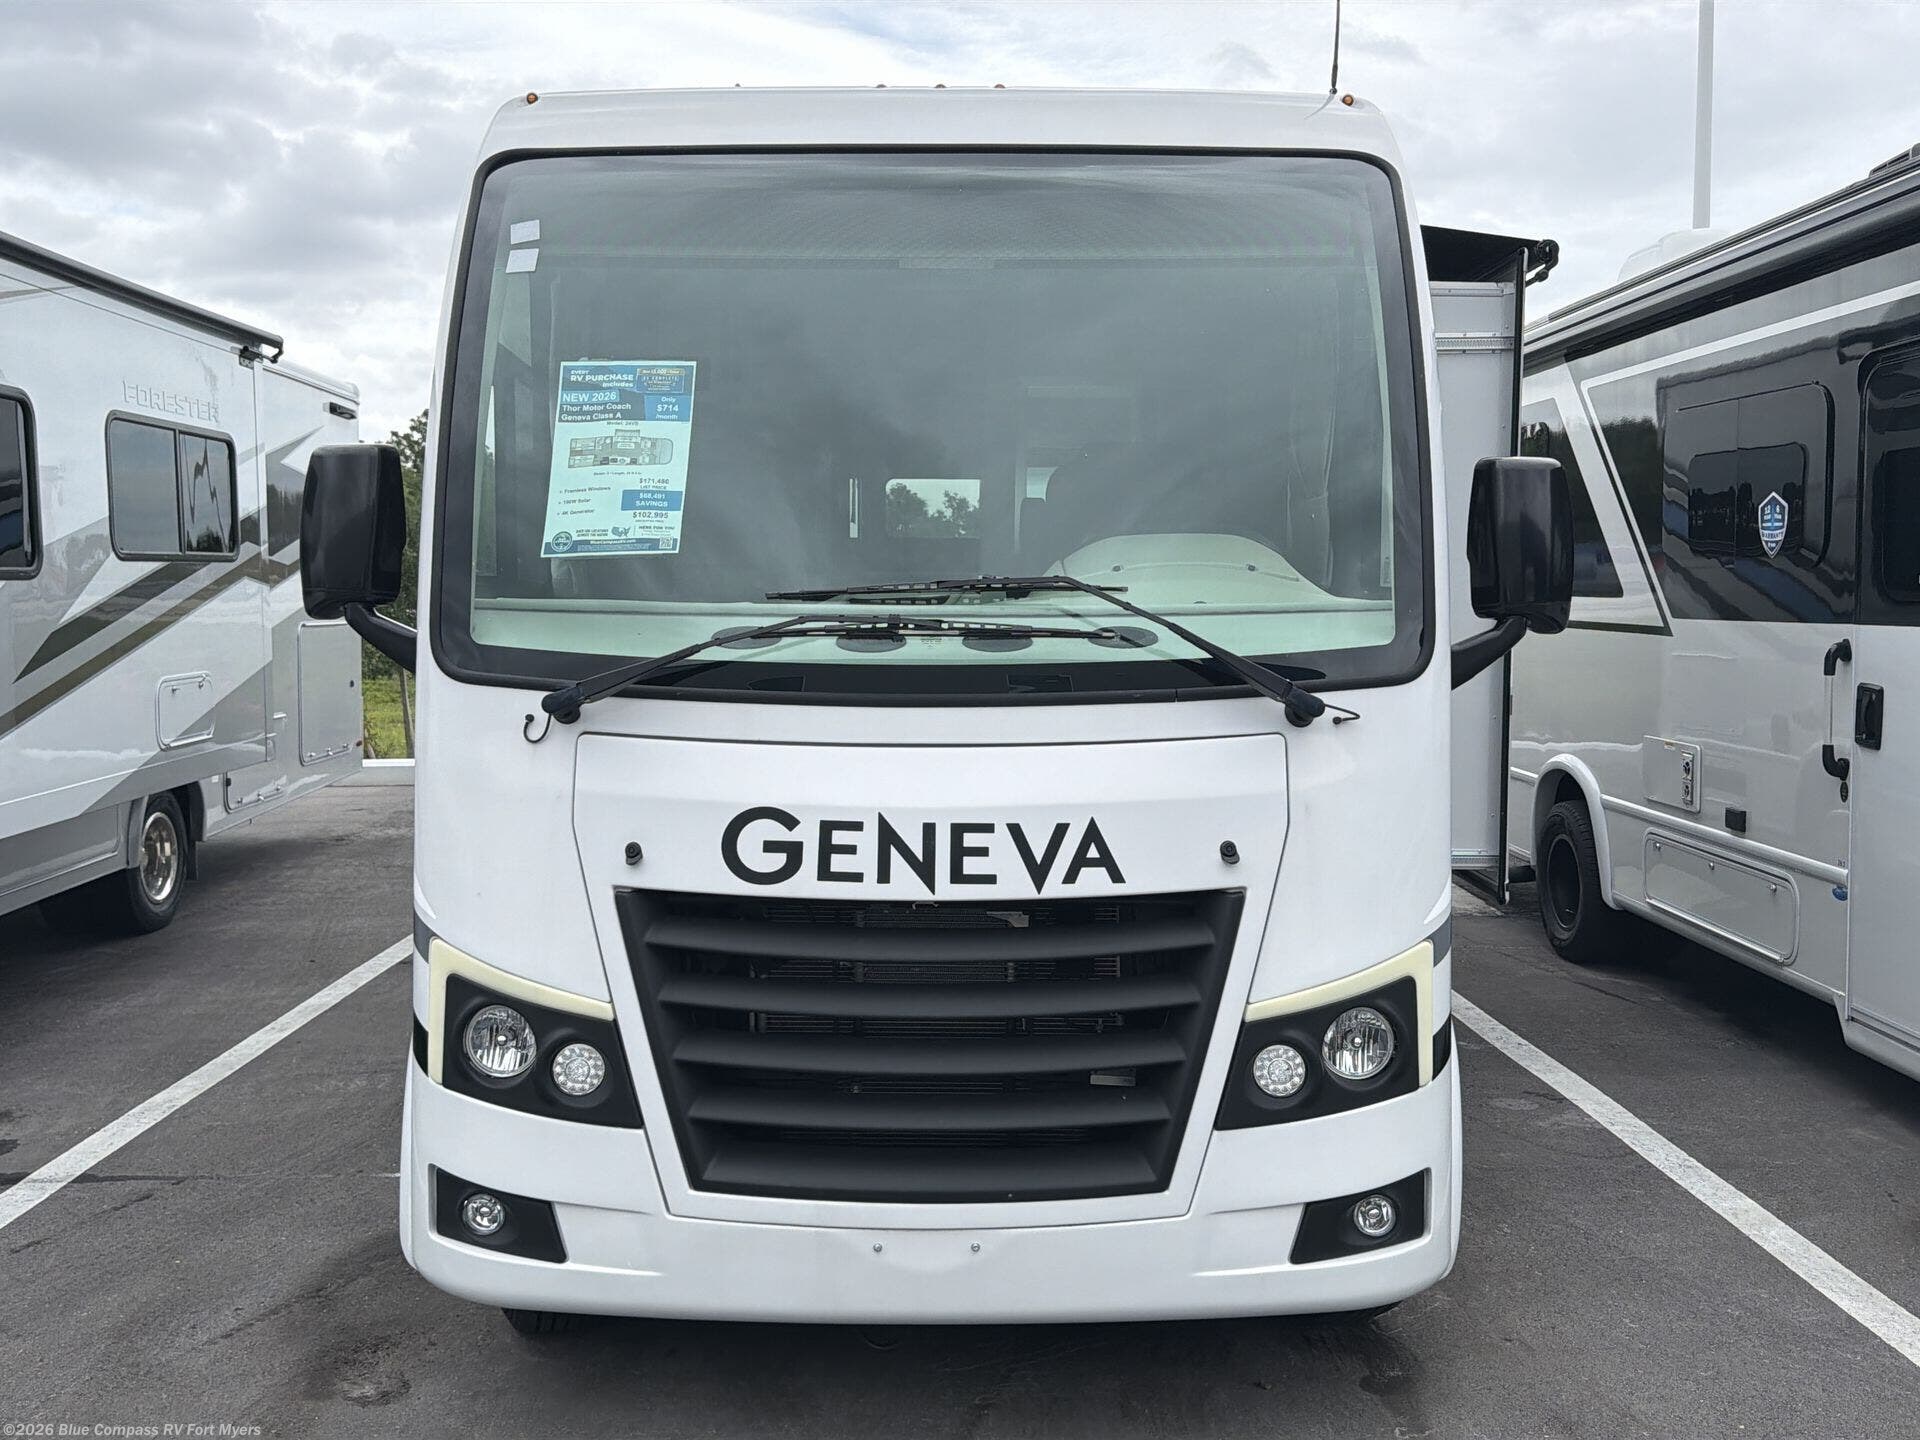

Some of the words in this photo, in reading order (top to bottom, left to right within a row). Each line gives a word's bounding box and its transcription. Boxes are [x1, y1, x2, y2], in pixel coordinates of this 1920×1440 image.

[123, 380, 218, 423] FORESTER
[562, 393, 589, 402] NEW
[592, 391, 617, 402] 2026
[561, 413, 591, 421] Geneva
[632, 511, 669, 519] $102,995
[721, 806, 1126, 895] GENEVA
